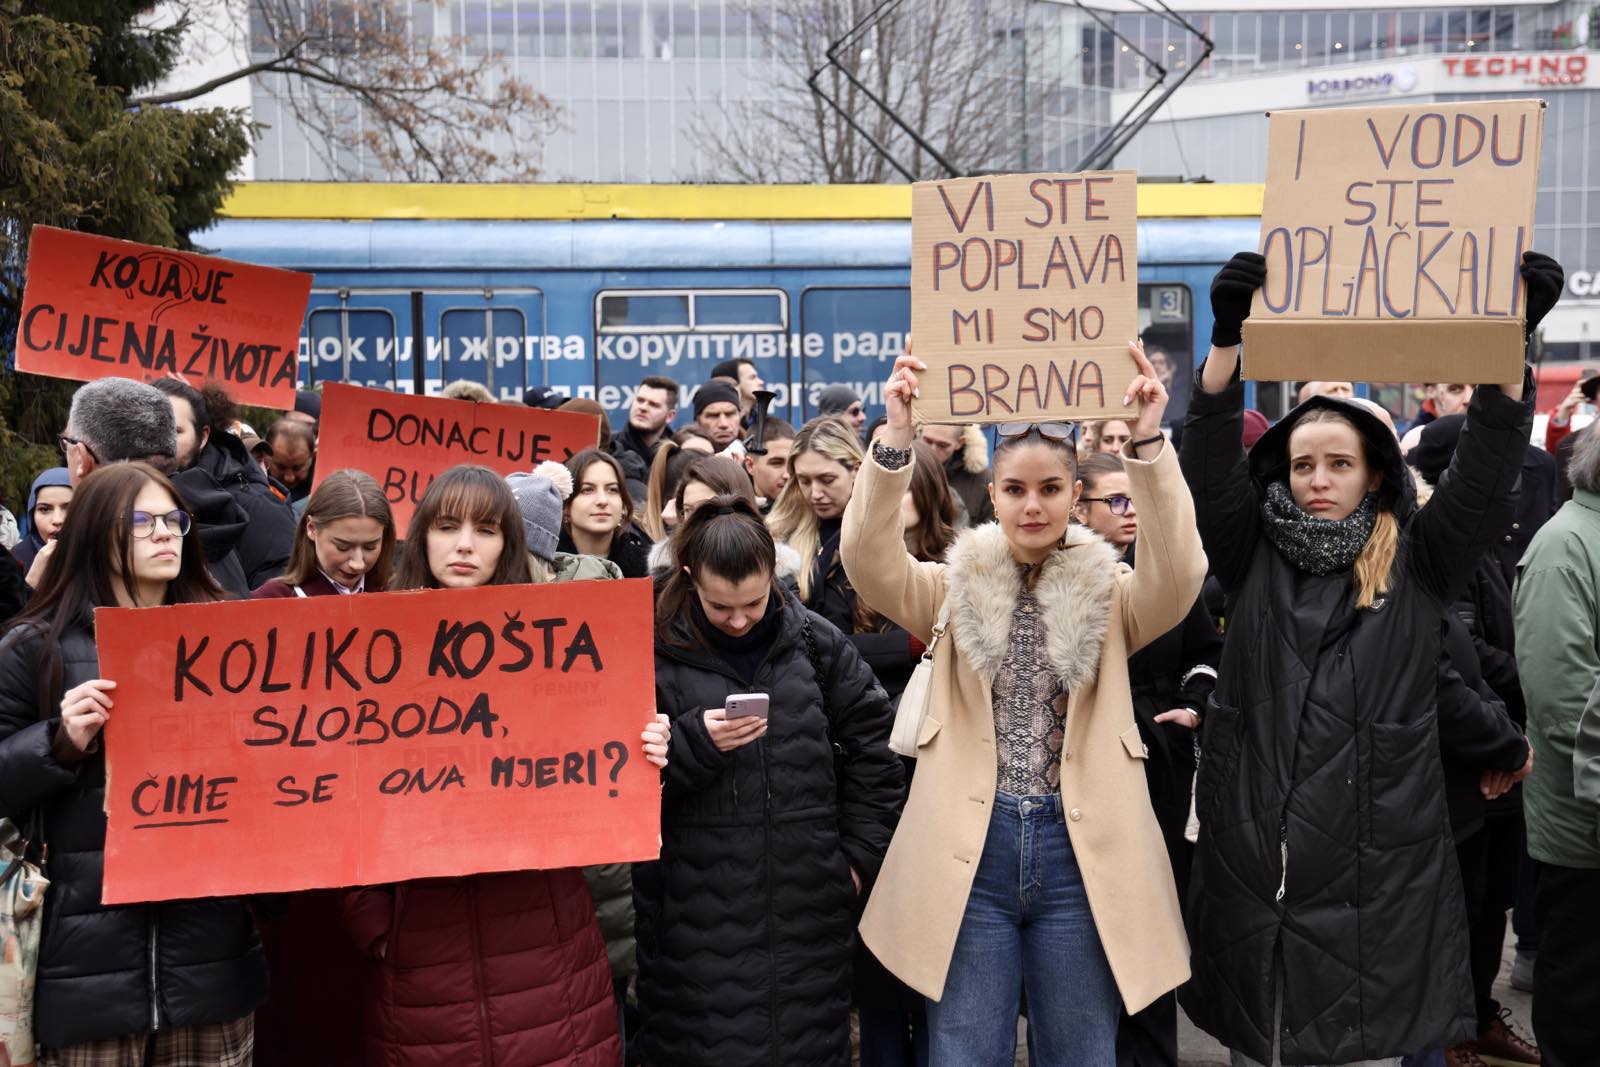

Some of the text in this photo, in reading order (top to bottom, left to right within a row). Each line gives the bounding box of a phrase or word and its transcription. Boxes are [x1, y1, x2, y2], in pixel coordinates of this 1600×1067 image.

[1442, 55, 1587, 77] TECHNO
[1294, 113, 1526, 180] I VODU
[936, 177, 1114, 234] VI STE
[1344, 178, 1454, 228] STE
[191, 269, 234, 305] JE
[932, 233, 1125, 292] POPLAVA
[22, 303, 297, 389] CIJENA ŽIVOTA
[297, 336, 368, 368] док
[460, 334, 586, 368] жртва
[596, 333, 825, 367] коруптивне
[832, 331, 911, 364] рад
[952, 305, 1105, 346] MI SMO
[947, 360, 1105, 416] BRANA
[367, 408, 552, 465] DONACIJE
[173, 610, 604, 702] KOLIKO KOŠTA
[245, 692, 509, 747] SLOBODA,
[131, 772, 238, 817] ČIME
[272, 773, 340, 807] SE
[378, 766, 467, 796] ONA
[490, 740, 630, 798] MJERI?
